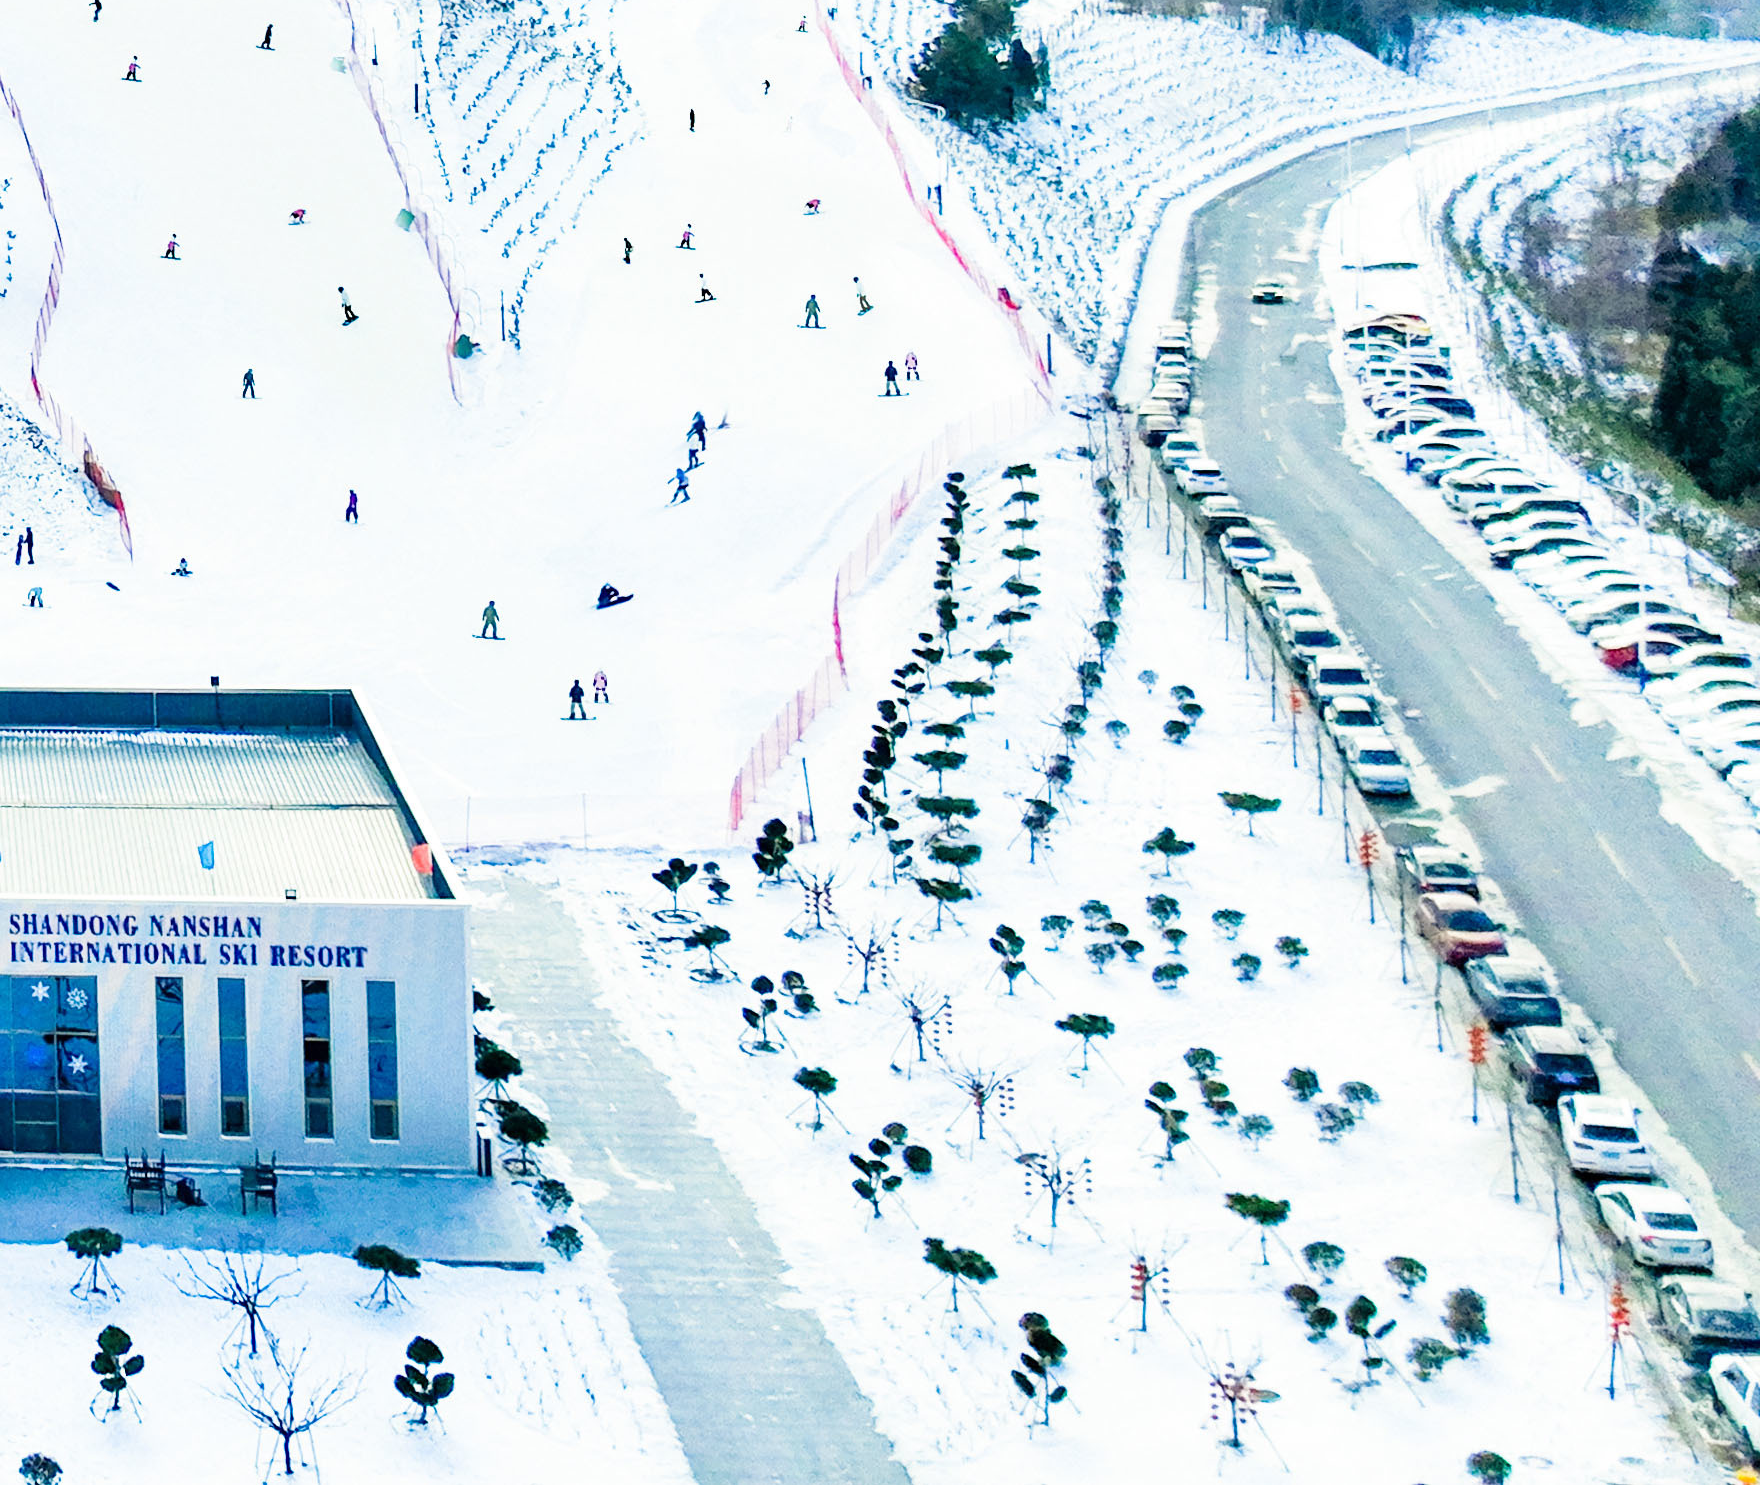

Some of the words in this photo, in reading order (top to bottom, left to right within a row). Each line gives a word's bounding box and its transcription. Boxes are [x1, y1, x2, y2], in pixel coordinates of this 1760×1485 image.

[9, 914, 139, 936] SHANDONG
[150, 915, 262, 938] NANSHAN
[10, 942, 207, 965] INTERNATIONAL
[219, 944, 258, 966] SKI
[270, 945, 368, 968] RESORT
